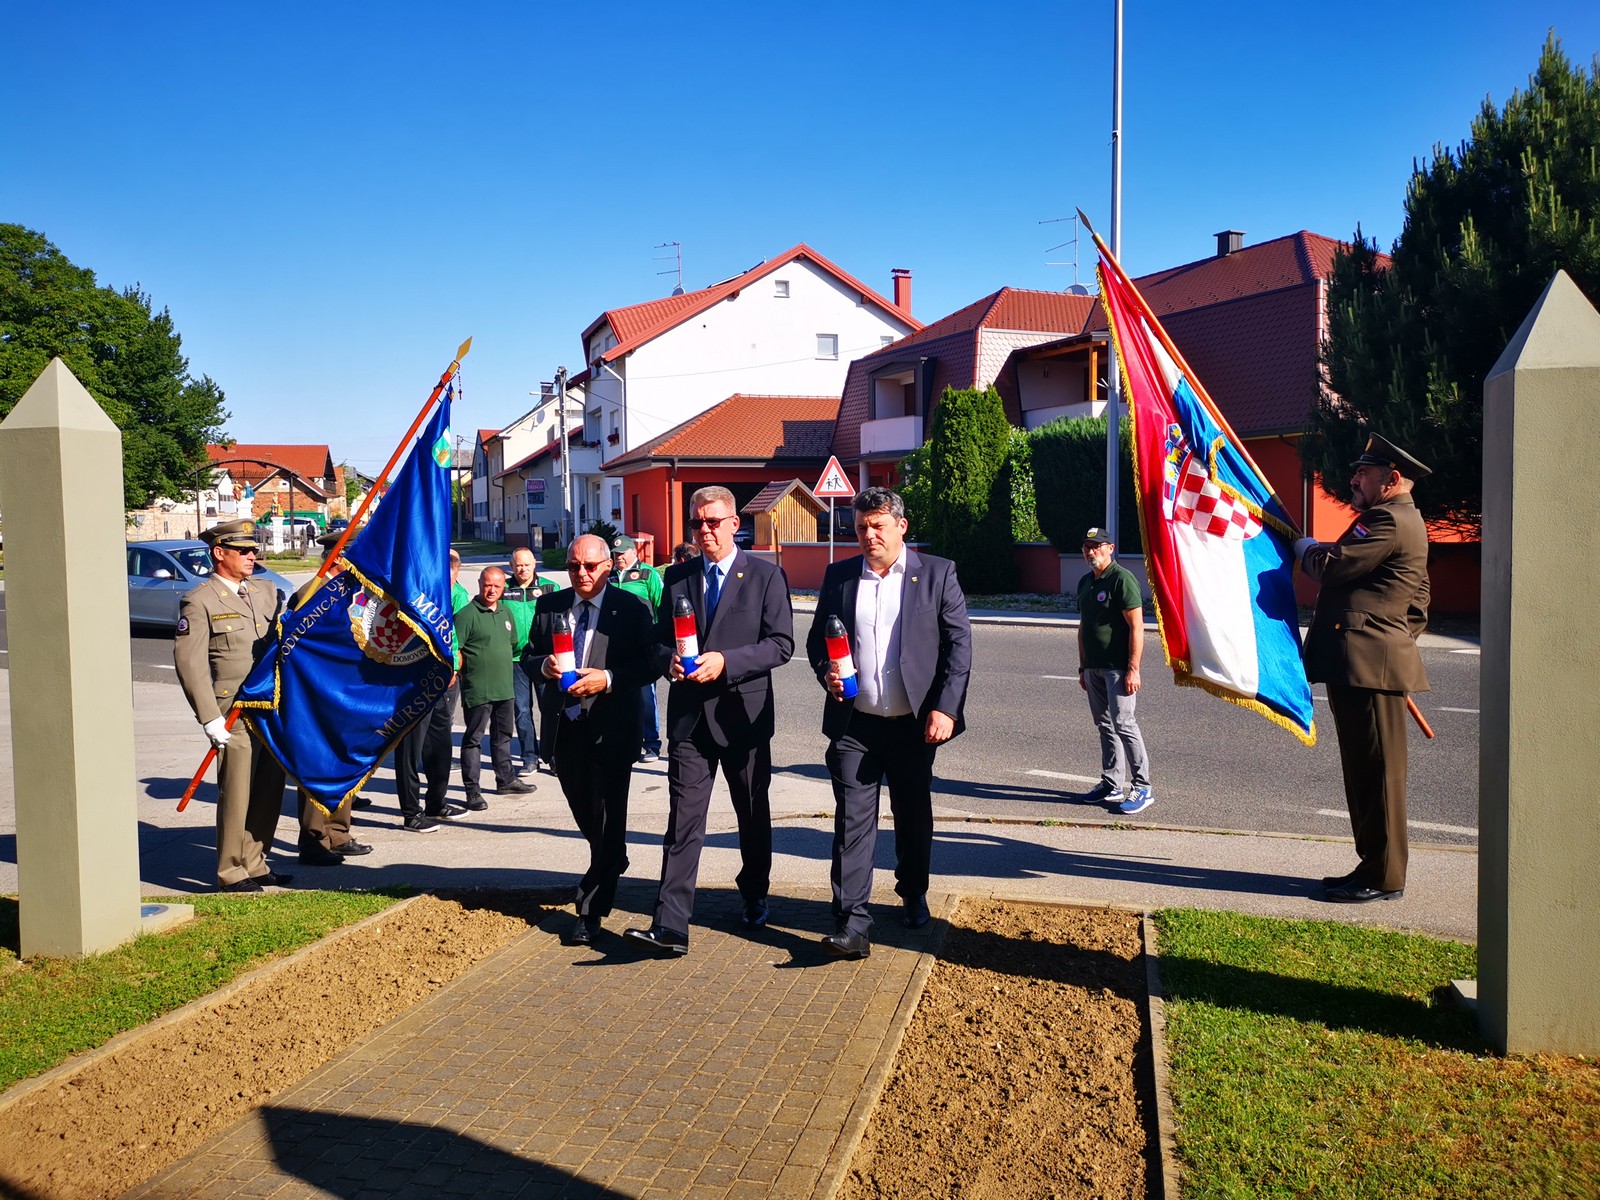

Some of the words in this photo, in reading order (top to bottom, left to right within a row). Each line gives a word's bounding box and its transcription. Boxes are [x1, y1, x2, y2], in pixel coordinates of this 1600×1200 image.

[411, 592, 454, 651] MURS
[392, 646, 428, 663] DOMOVIN
[375, 675, 446, 740] MURSKO
